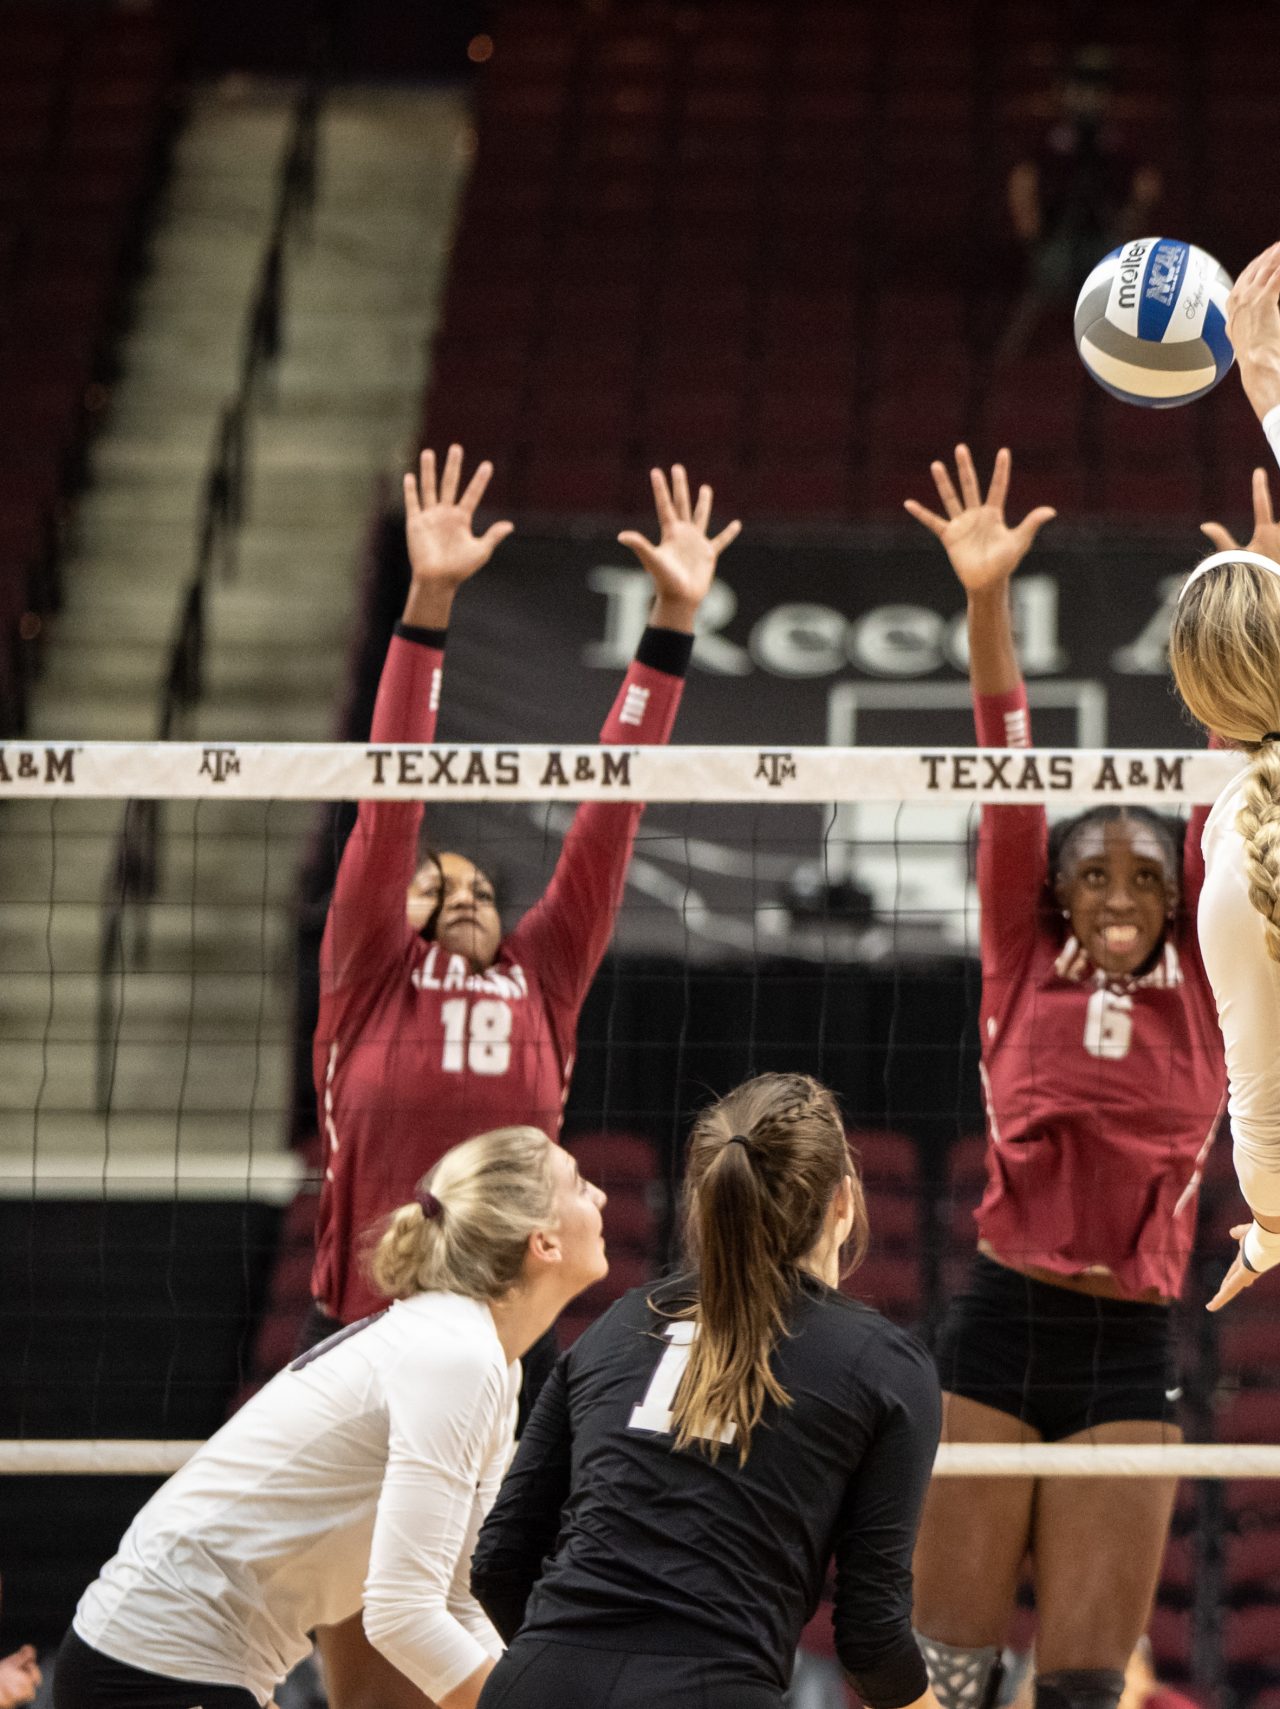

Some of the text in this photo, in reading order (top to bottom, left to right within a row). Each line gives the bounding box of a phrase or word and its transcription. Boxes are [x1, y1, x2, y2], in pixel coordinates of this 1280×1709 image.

[1145, 245, 1183, 305] NCAA
[366, 751, 632, 787] TEXAS A&M
[921, 755, 1186, 791] TEXAS A&M
[440, 998, 513, 1075] 18
[1083, 989, 1133, 1060] 6
